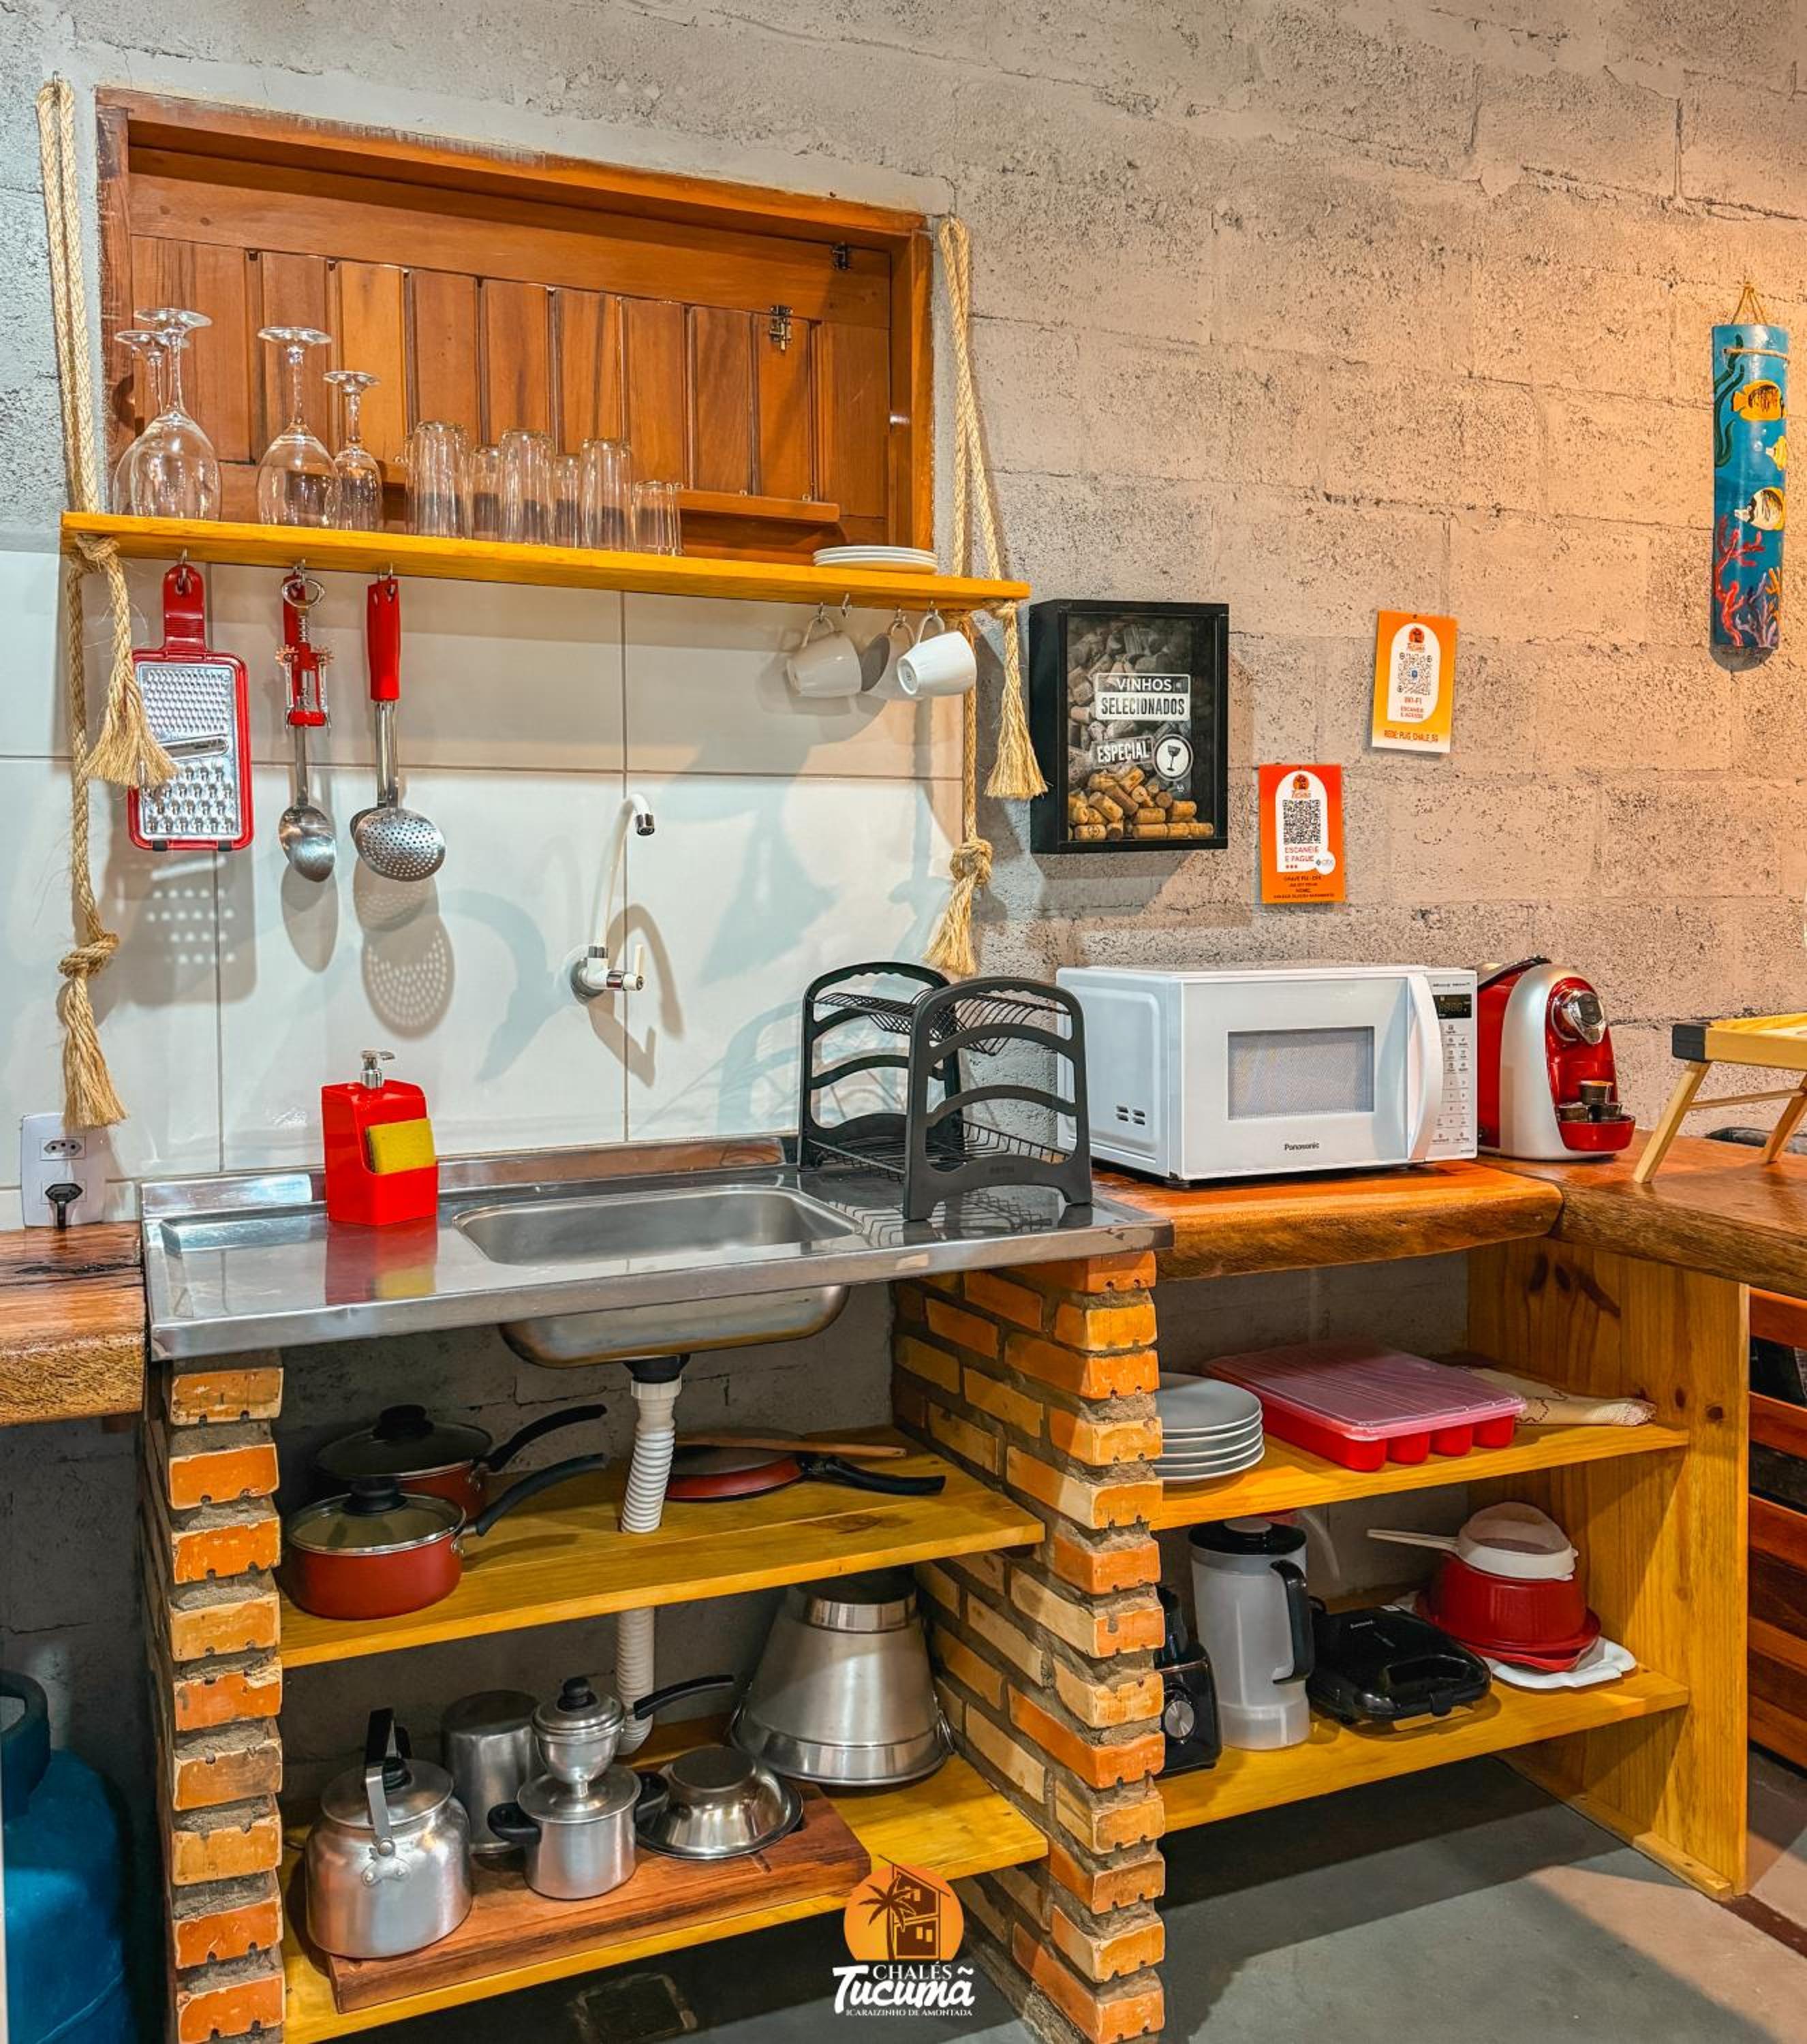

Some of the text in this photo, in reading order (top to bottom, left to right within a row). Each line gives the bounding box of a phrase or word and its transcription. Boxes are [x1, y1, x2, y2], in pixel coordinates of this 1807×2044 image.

[1116, 678, 1173, 692] VINHOS
[1101, 697, 1186, 715] SELECIONADOS
[1096, 740, 1150, 763] ESPECIAL
[1284, 1142, 1320, 1151] Panasonic
